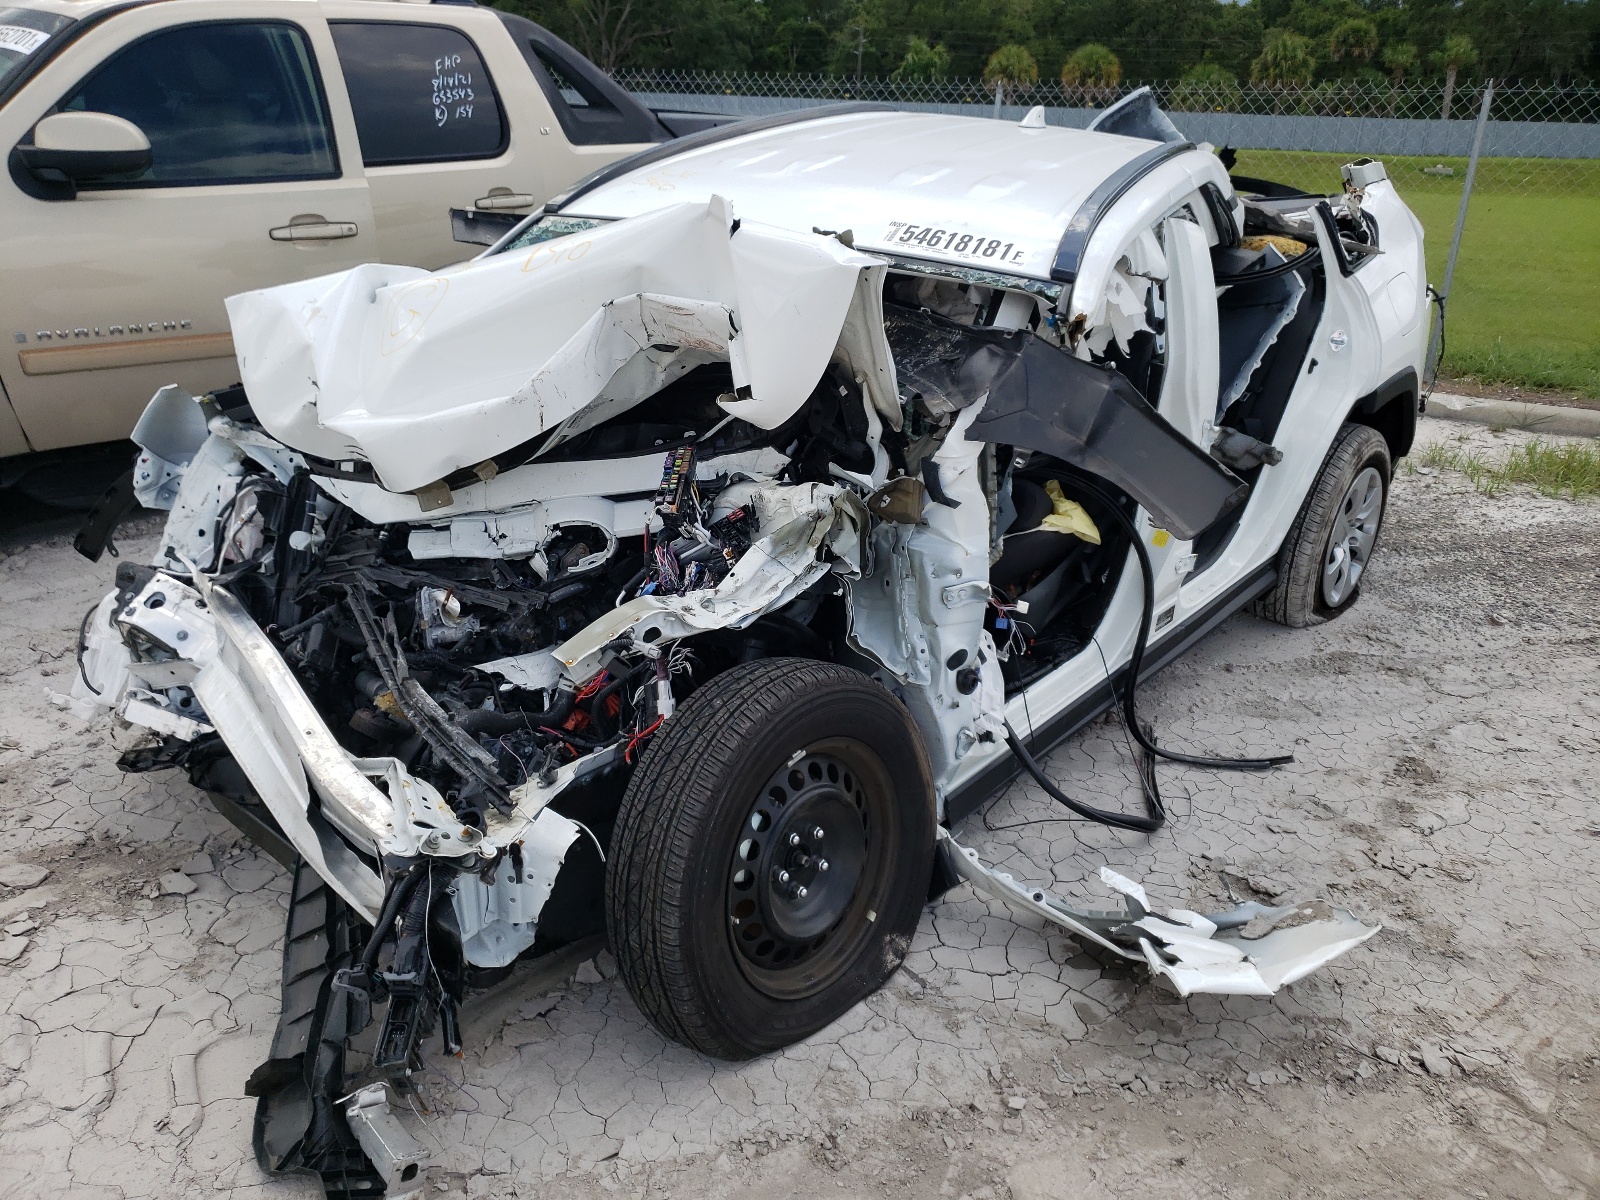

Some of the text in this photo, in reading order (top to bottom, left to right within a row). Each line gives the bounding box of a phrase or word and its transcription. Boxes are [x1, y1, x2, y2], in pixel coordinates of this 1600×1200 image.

[435, 55, 461, 76] FHP
[888, 220, 908, 228] INSP
[898, 224, 1014, 261] 54618181
[1011, 250, 1025, 261] F
[36, 319, 193, 341] AVALANCHE
